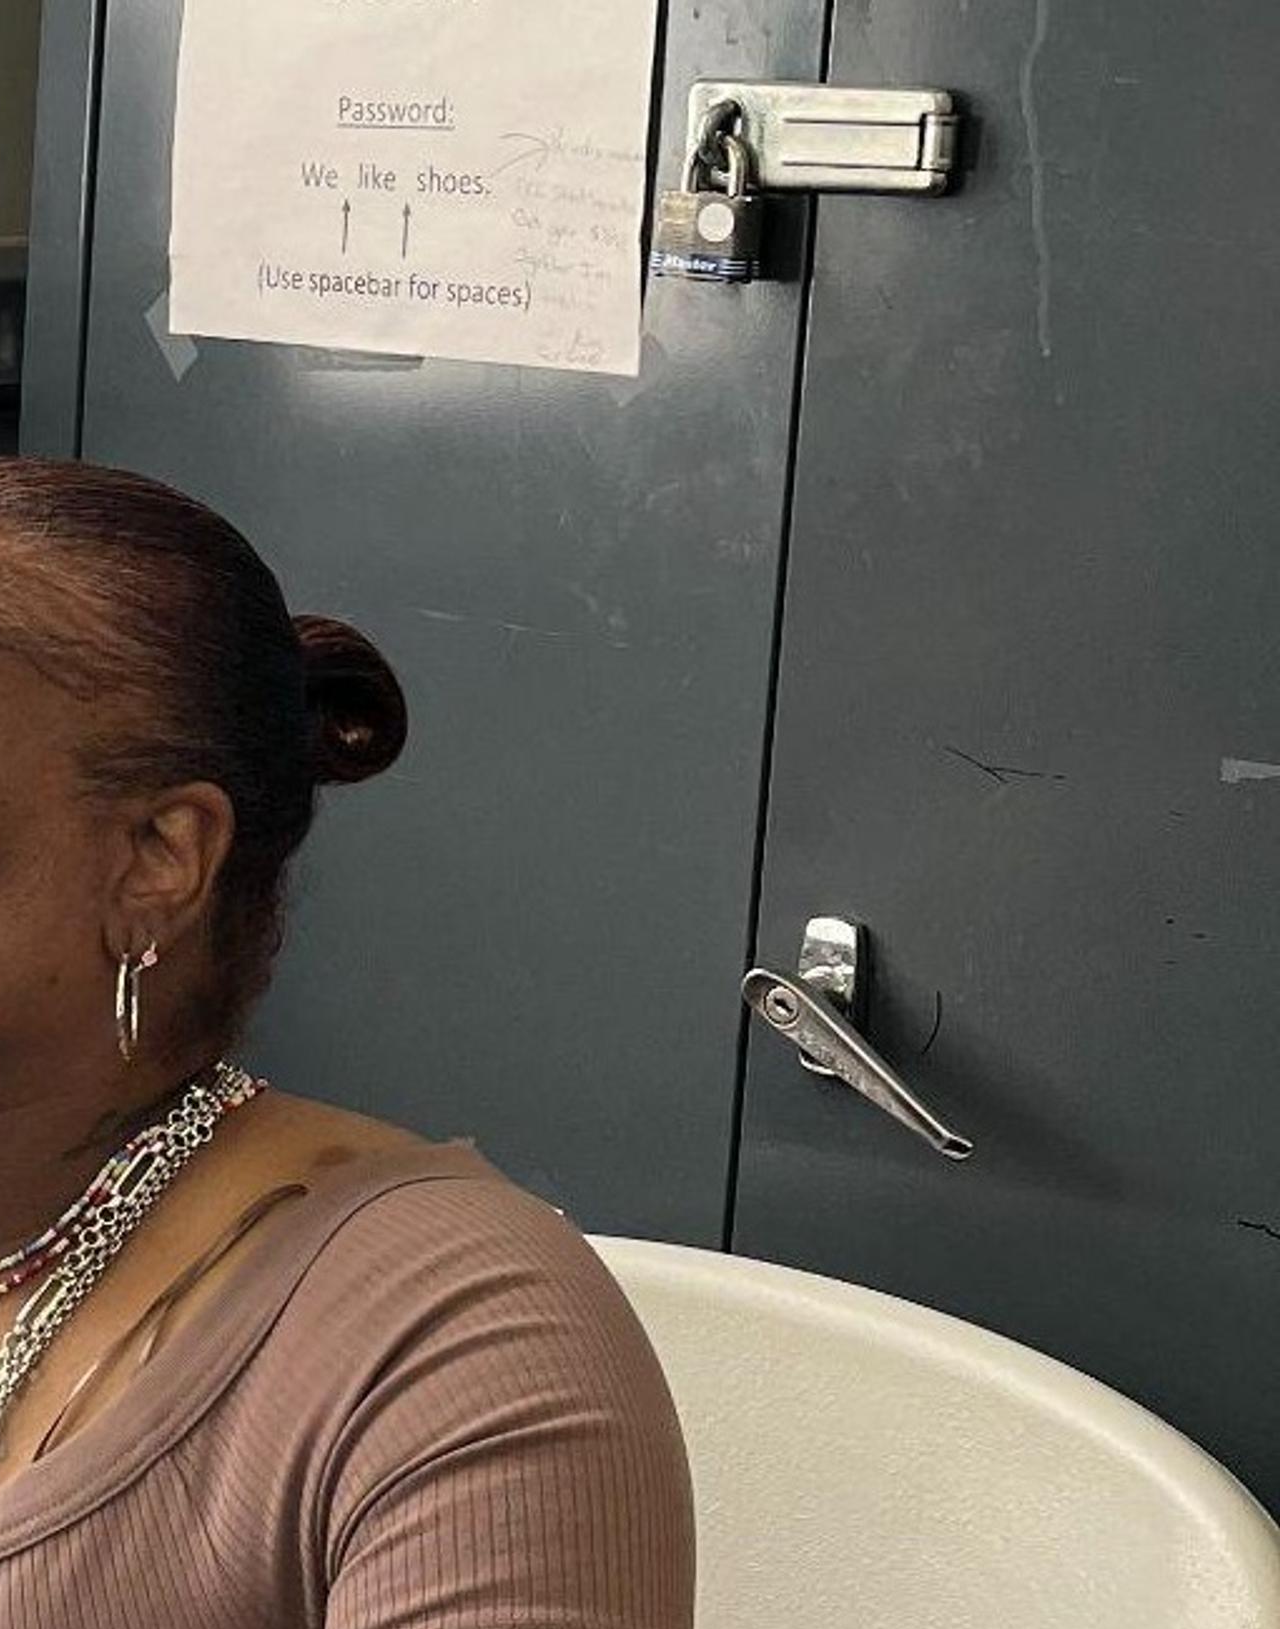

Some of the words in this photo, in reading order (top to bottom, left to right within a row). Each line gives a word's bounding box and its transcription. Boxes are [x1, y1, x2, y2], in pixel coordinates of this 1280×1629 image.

[337, 96, 456, 129] Password:
[300, 163, 339, 191] We
[356, 163, 397, 193] like
[416, 167, 493, 199] shoes.
[257, 264, 304, 293] (Use
[308, 271, 402, 303] spacebar
[407, 278, 440, 302] for
[446, 281, 533, 312] spaces)
